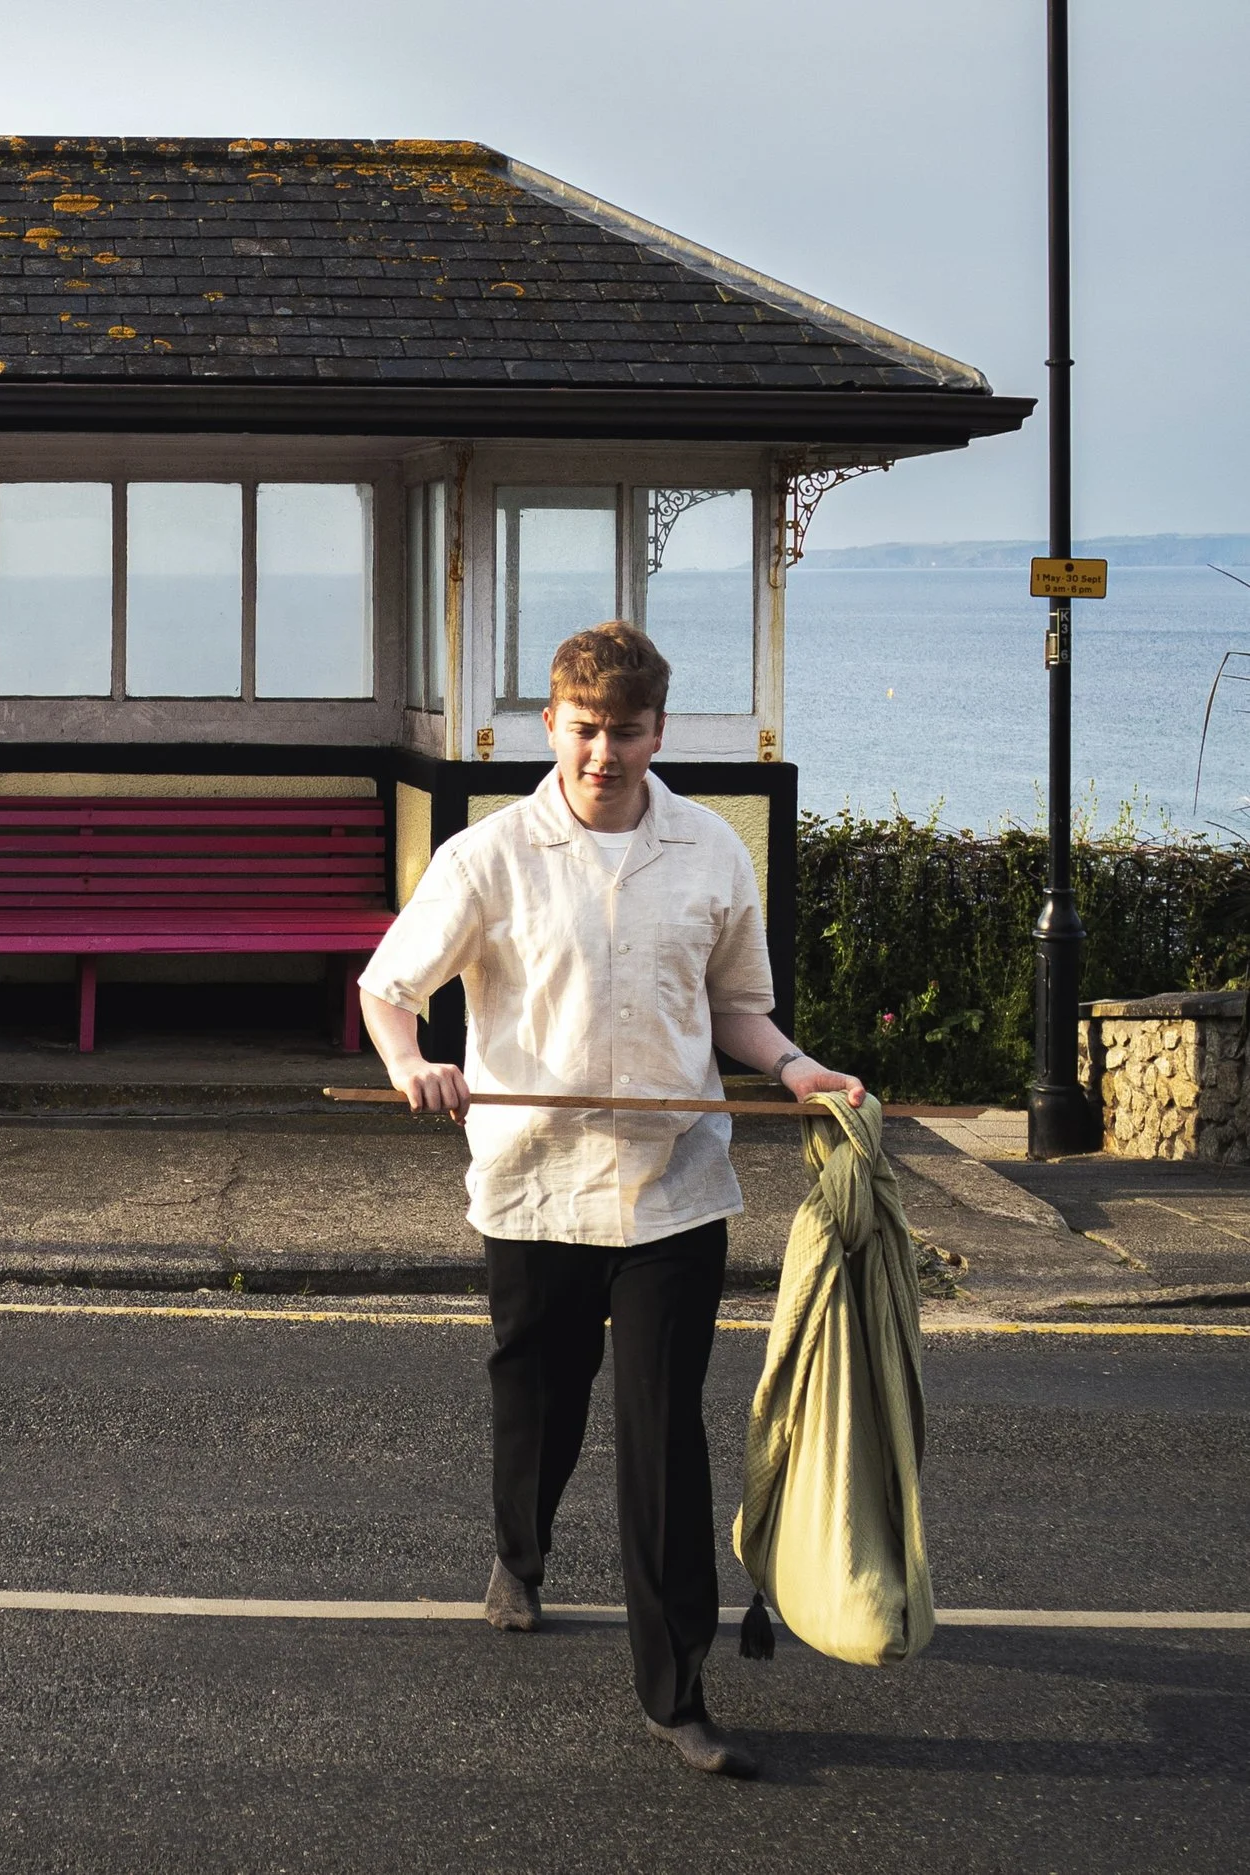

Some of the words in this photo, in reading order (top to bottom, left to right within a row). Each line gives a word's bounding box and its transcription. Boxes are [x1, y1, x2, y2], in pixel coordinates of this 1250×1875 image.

[1081, 575, 1101, 584] Sept
[1045, 584, 1051, 593] 9
[1078, 586, 1092, 594] pm
